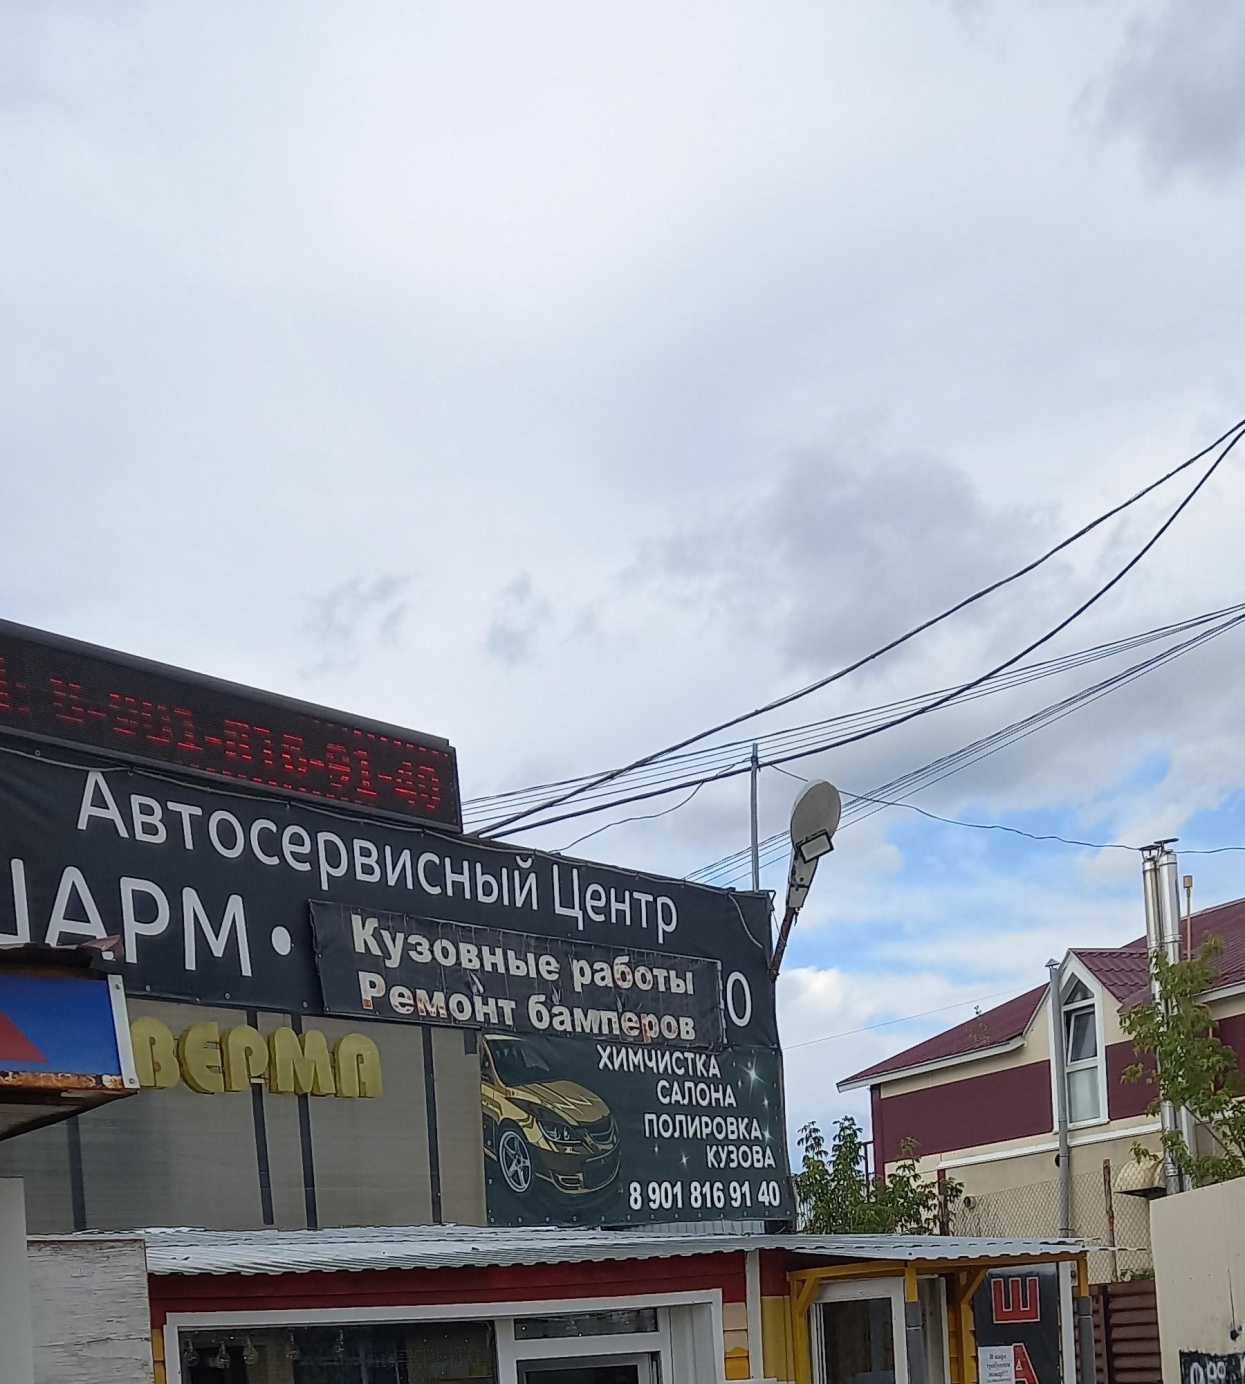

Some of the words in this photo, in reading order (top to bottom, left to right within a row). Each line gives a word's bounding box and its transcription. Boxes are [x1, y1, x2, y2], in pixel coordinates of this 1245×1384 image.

[77, 771, 538, 912] Автосервисный
[552, 864, 678, 944] Центр
[351, 912, 560, 981] Кузовные
[572, 955, 695, 996] работы
[358, 972, 516, 1027] Ремонт
[528, 994, 696, 1041] бамперов
[597, 1045, 721, 1078] ХИМЧИСТКА
[657, 1080, 736, 1107] САЛОНА
[644, 1113, 763, 1141] ПОЛИРОВКА
[706, 1145, 776, 1169] КУЗОВА
[629, 1182, 642, 1210] 8
[648, 1182, 683, 1209] 901
[690, 1181, 725, 1208] 816
[730, 1181, 751, 1207] 91
[758, 1181, 781, 1206] 40
